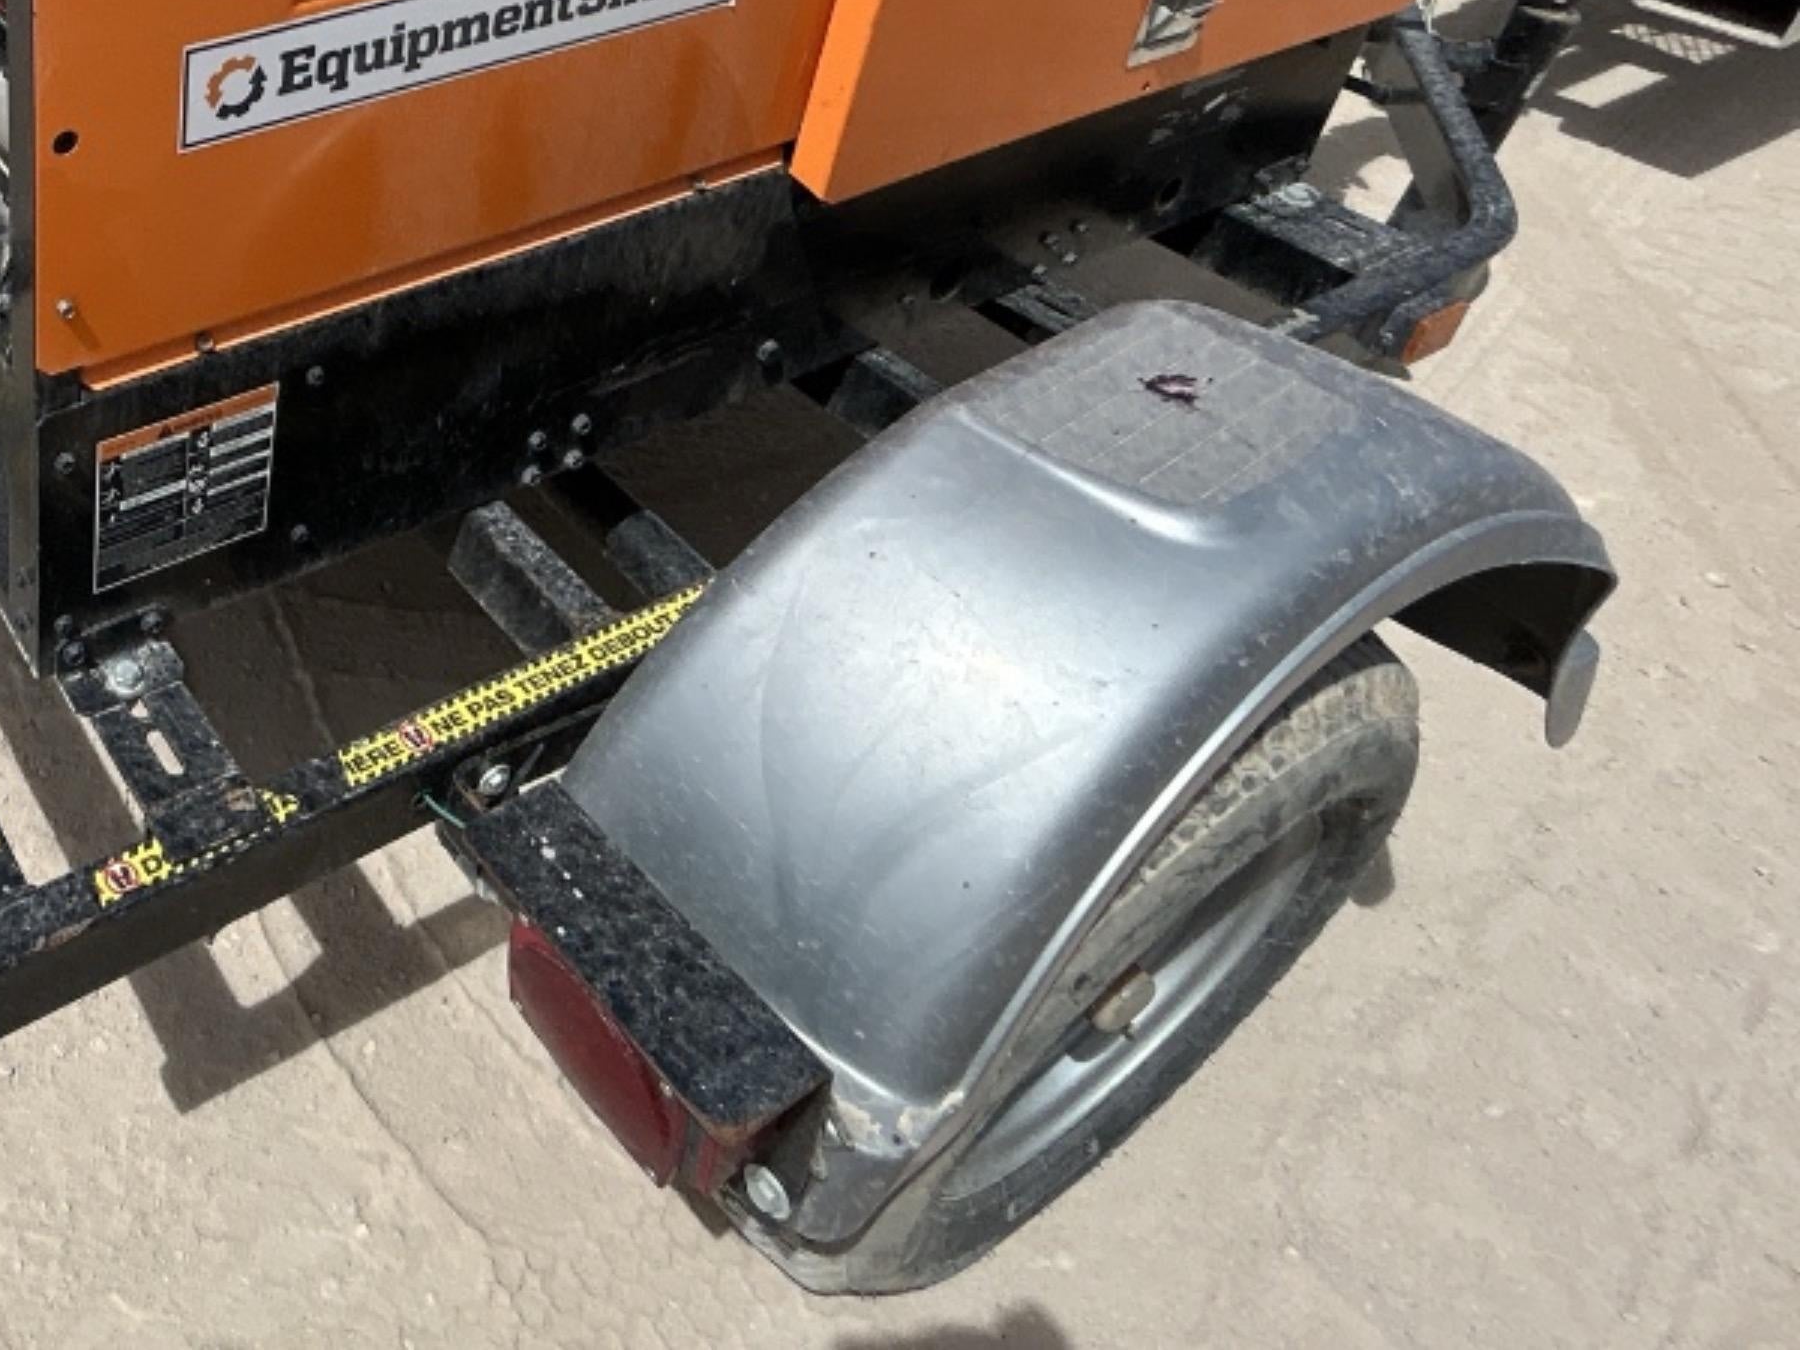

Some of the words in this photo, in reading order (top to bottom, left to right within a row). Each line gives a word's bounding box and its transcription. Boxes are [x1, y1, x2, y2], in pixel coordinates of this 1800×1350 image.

[430, 709, 467, 737] NE
[469, 687, 517, 719] PAS
[518, 654, 587, 693] TENEZ
[588, 613, 675, 661] DEBOUT
